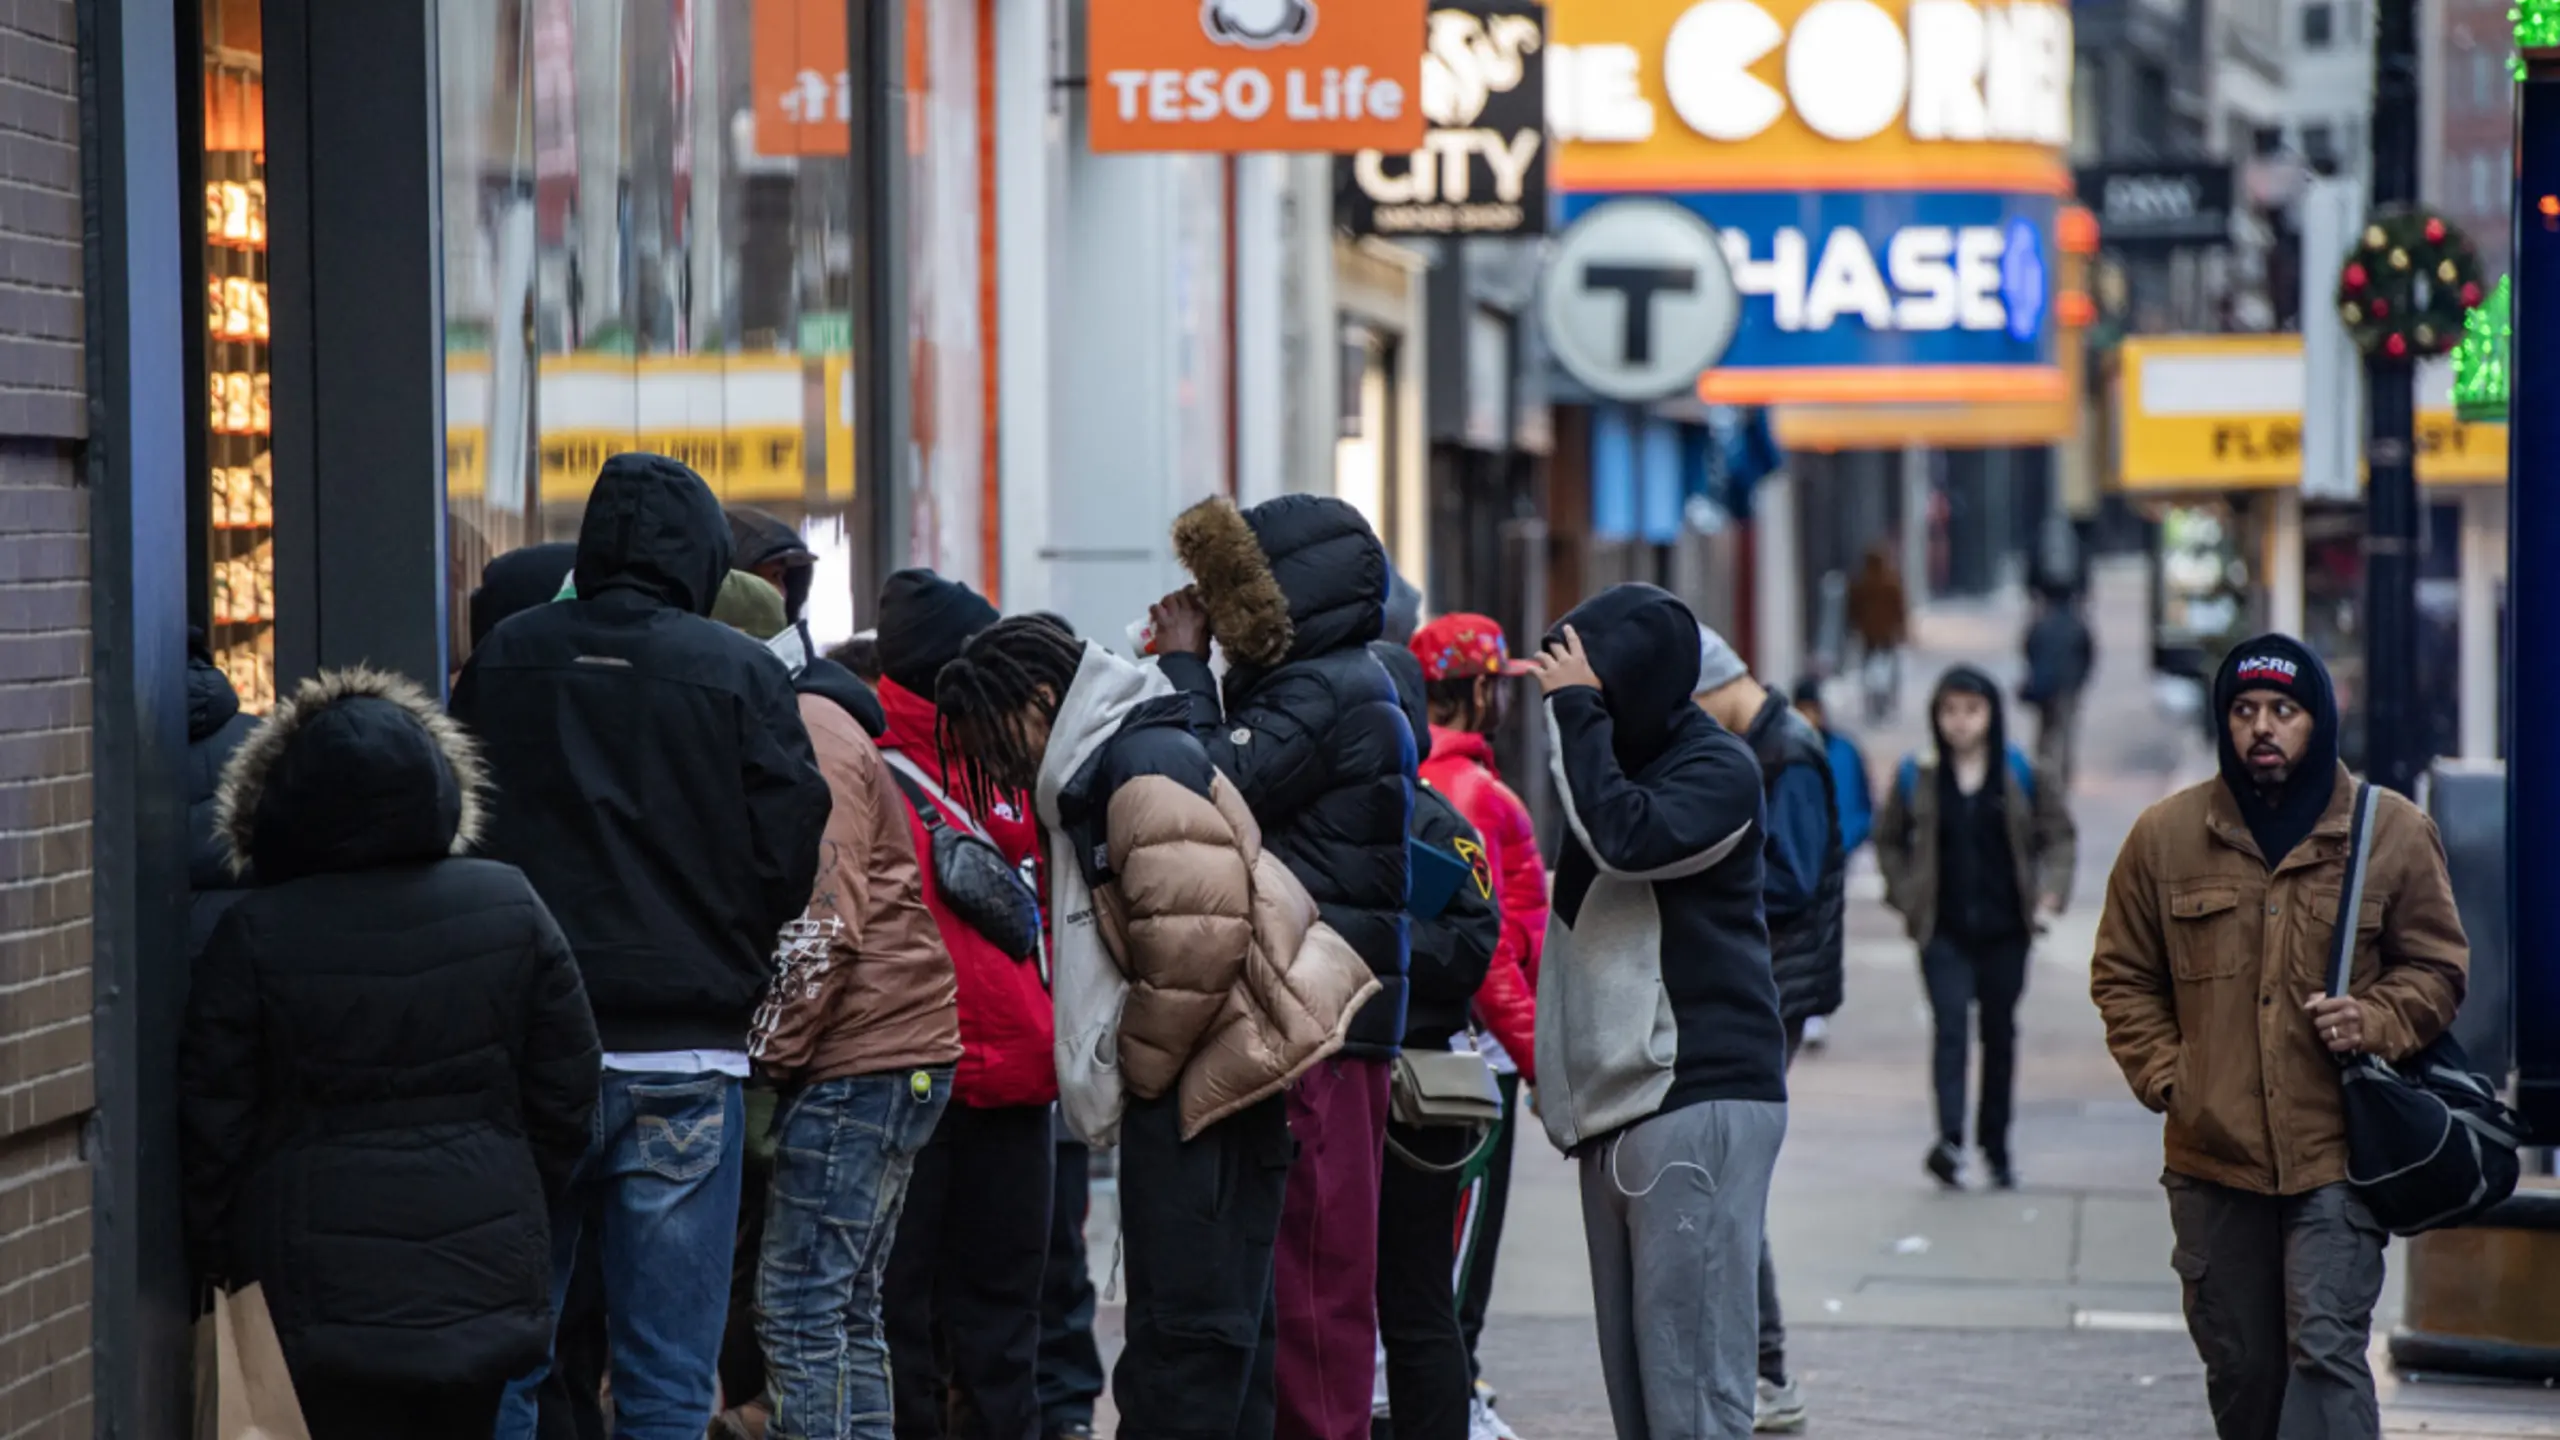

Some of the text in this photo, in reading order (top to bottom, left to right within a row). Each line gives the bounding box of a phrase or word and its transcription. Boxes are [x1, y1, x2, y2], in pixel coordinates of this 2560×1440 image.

[1106, 66, 1404, 122] TESO Life
[1354, 128, 1541, 204] CITY
[1584, 264, 1696, 366] T
[1719, 226, 2007, 331] HASE
